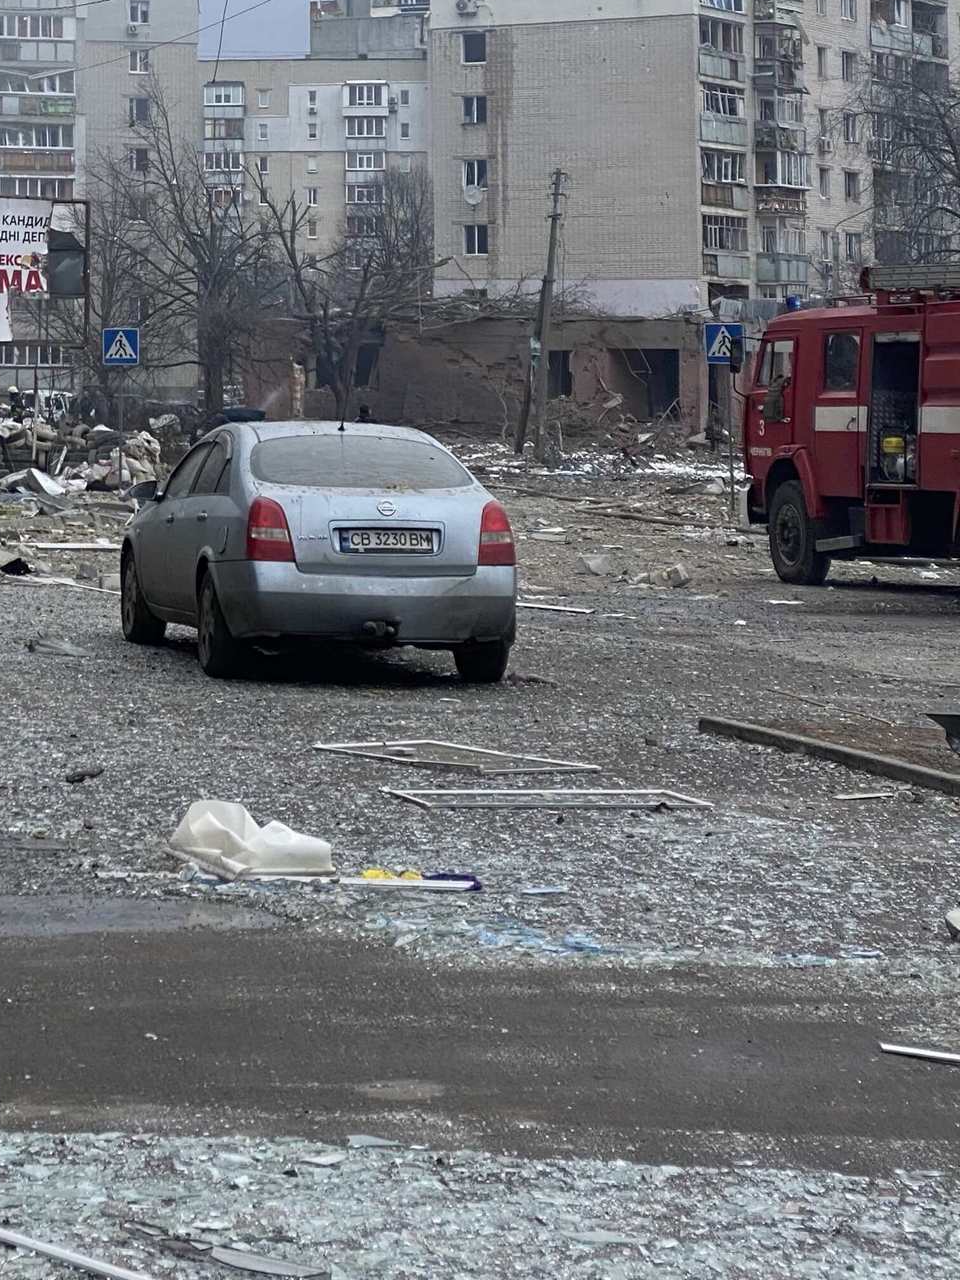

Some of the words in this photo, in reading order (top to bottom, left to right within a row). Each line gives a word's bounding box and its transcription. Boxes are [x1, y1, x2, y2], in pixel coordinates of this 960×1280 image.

[759, 419, 765, 436] 3
[350, 532, 371, 546] CB
[375, 532, 407, 546] 3230
[409, 533, 431, 547] BM
